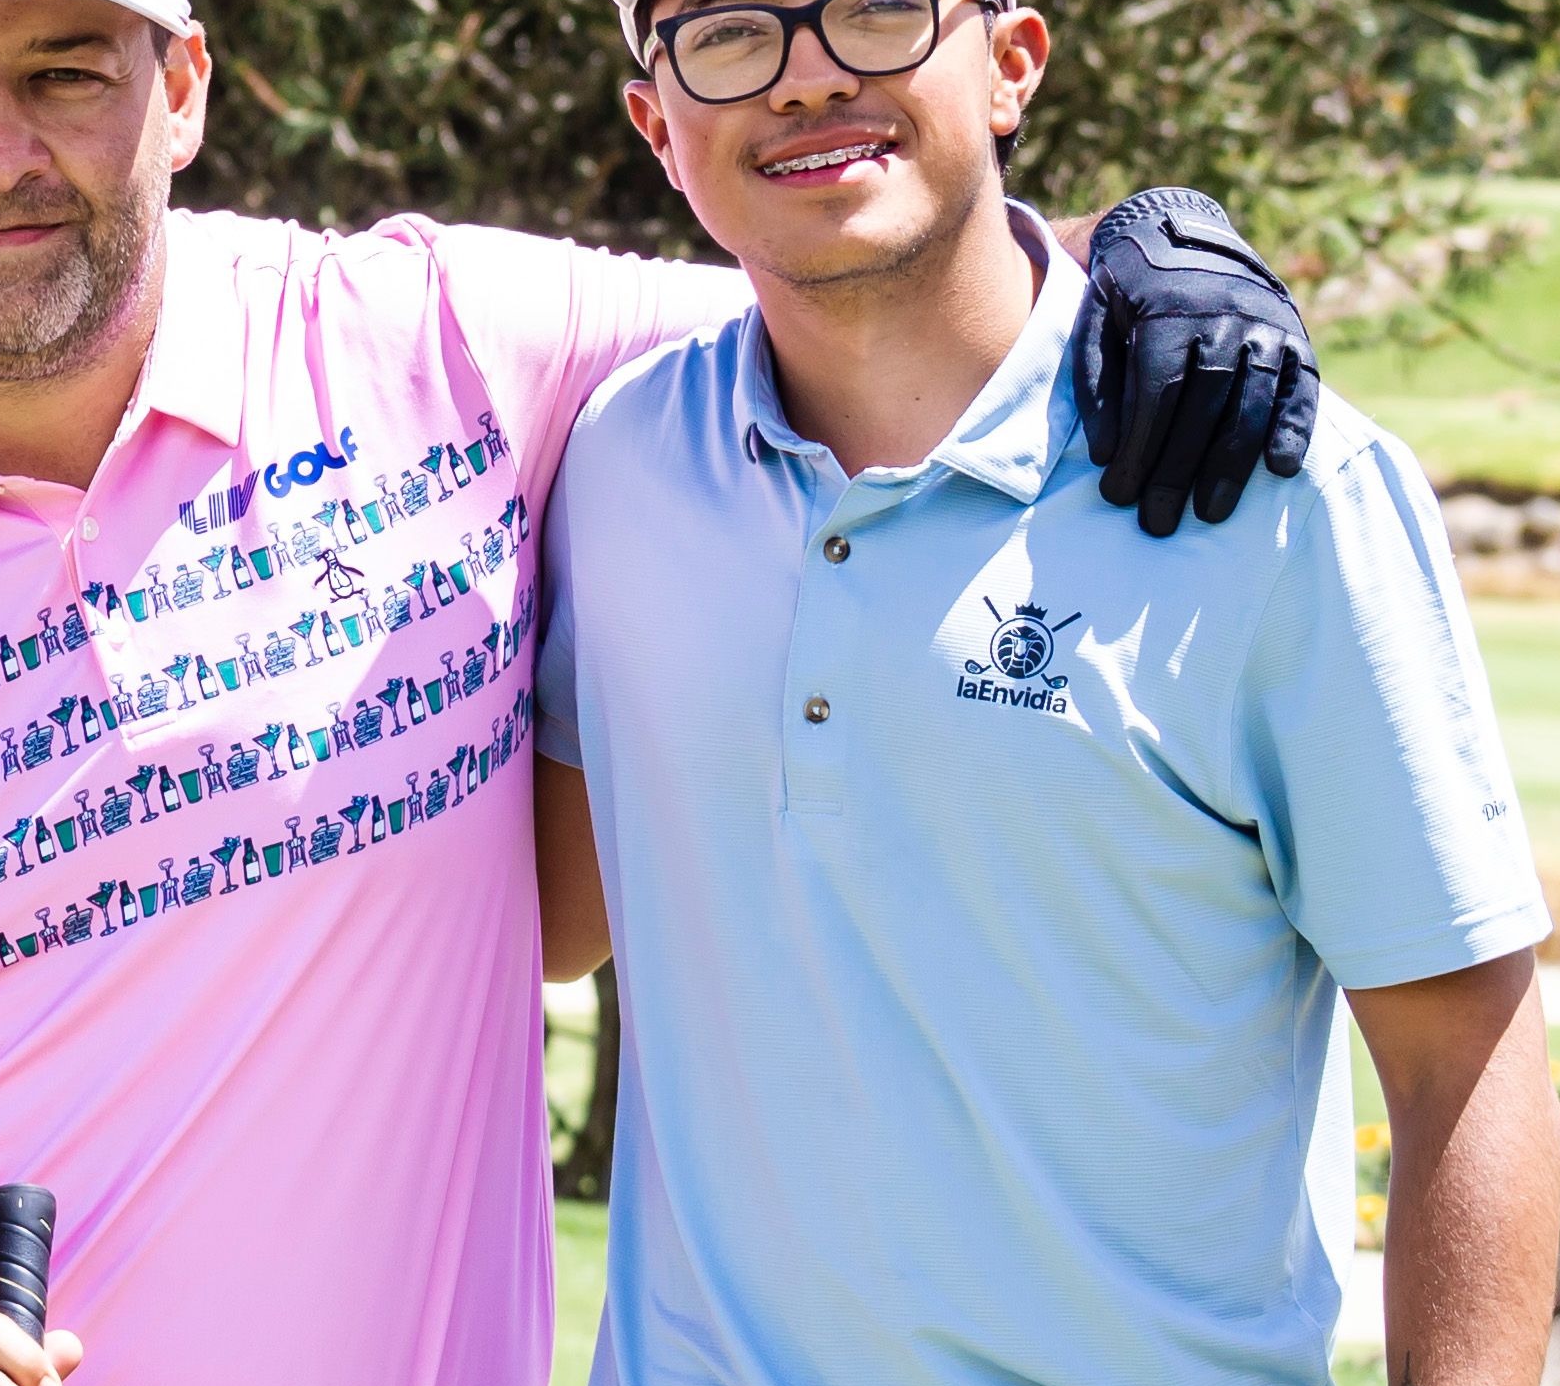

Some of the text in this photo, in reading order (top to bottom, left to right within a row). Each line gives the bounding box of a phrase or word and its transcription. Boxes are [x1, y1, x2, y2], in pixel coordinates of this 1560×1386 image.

[178, 425, 359, 536] LIV GOLF
[956, 675, 1068, 714] laEnvidia
